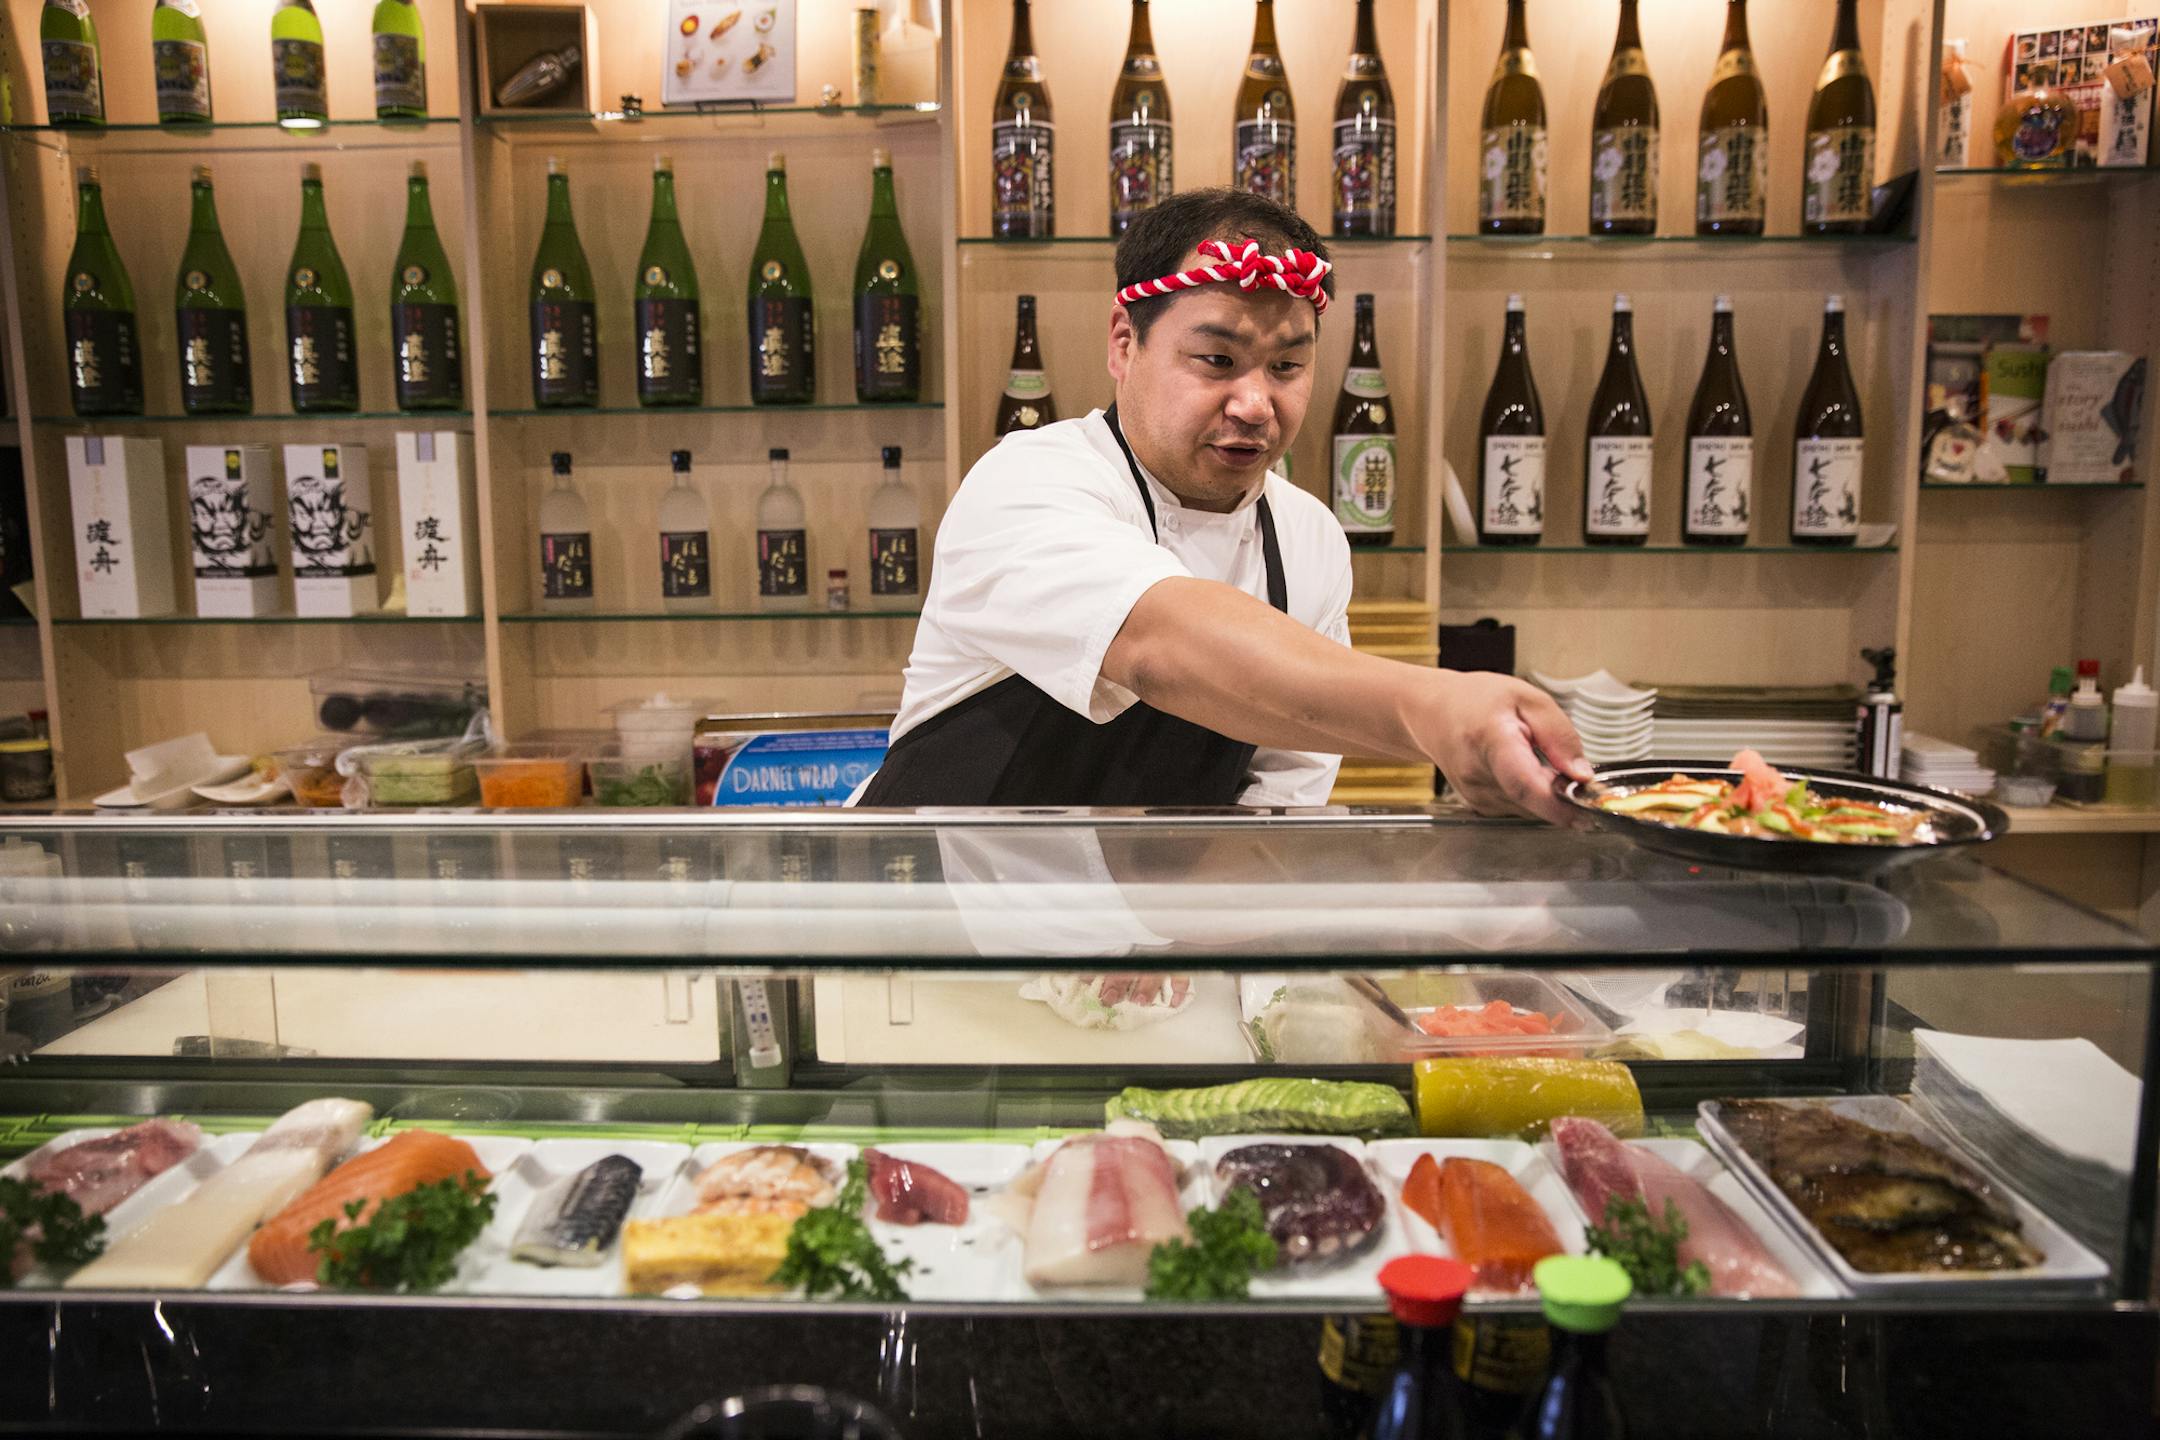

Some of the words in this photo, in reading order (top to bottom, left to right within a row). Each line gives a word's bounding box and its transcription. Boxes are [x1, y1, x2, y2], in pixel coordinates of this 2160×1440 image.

[86, 519, 120, 574] 渡舟
[415, 515, 450, 572] 渡舟
[732, 766, 795, 793] DARNEL
[798, 763, 839, 789] WRAP
